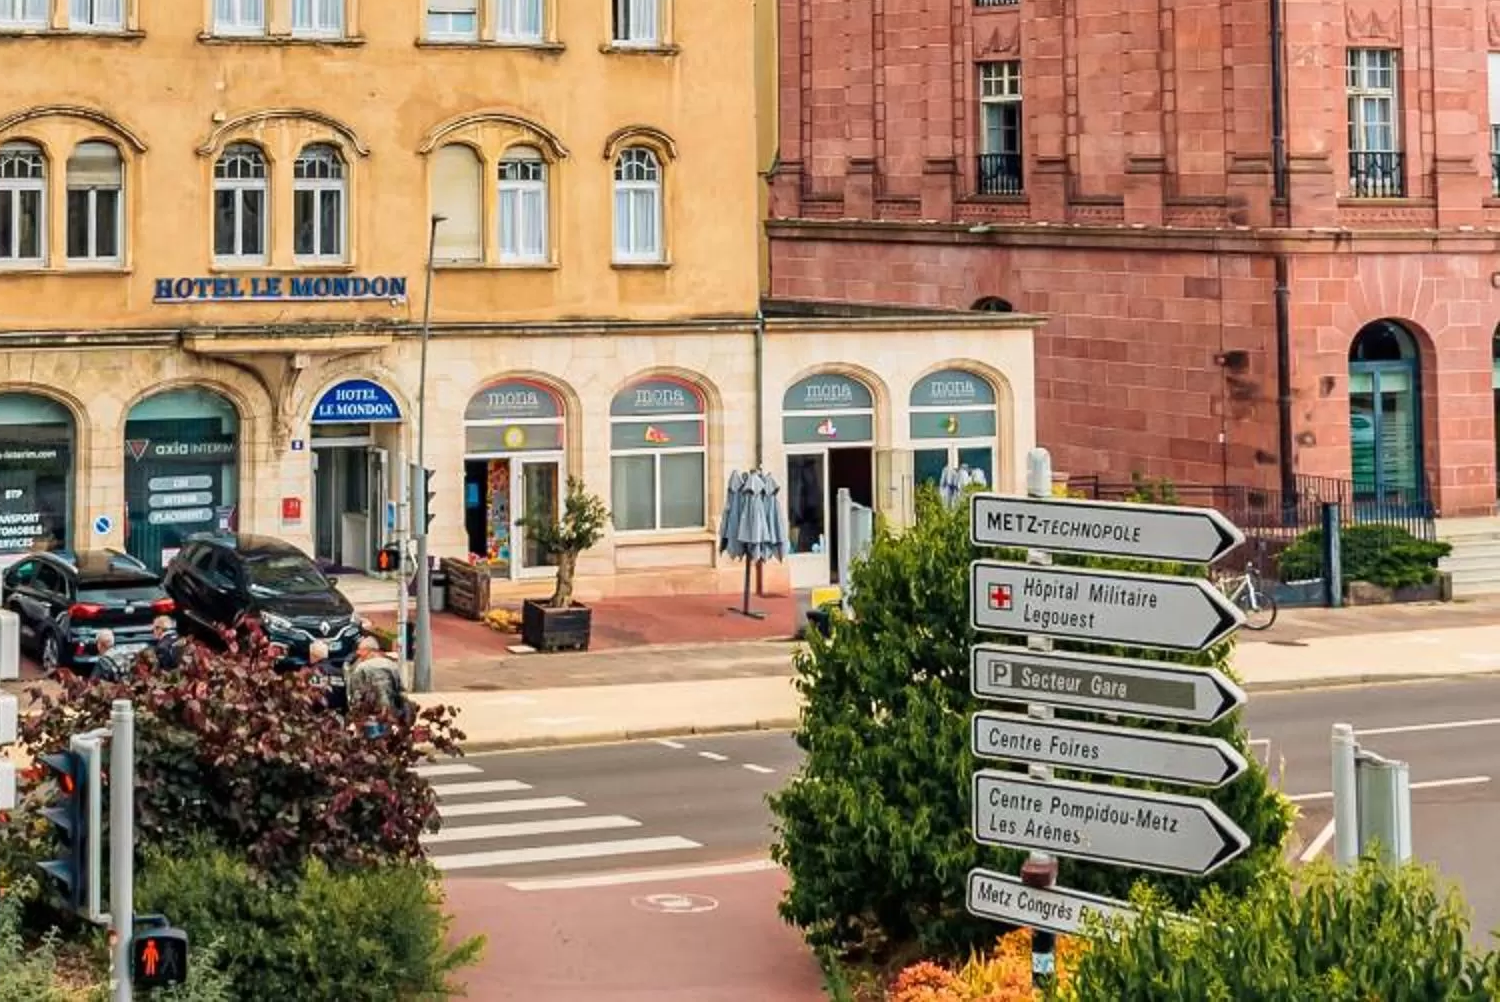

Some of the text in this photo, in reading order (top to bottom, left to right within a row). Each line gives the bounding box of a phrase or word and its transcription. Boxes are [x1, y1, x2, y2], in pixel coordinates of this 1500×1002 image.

[154, 276, 407, 298] HOTEL LE MONDON
[335, 388, 379, 401] HOTEL
[487, 391, 539, 406] mona
[636, 389, 685, 401] mona
[805, 384, 852, 398] mona
[931, 381, 975, 396] mona
[319, 403, 393, 417] LE MONDON
[155, 441, 189, 455] axia
[1024, 577, 1157, 609] Hôpital Militaire
[1024, 605, 1095, 630] Legouest
[994, 664, 1128, 698] P Secteur Gare
[988, 727, 1100, 759] Centre Foires
[988, 787, 1179, 834] Centre Pompidou-Metz
[989, 814, 1082, 845] Les Arènes
[977, 881, 1012, 907] Metz
[1016, 891, 1074, 923] Congrès
